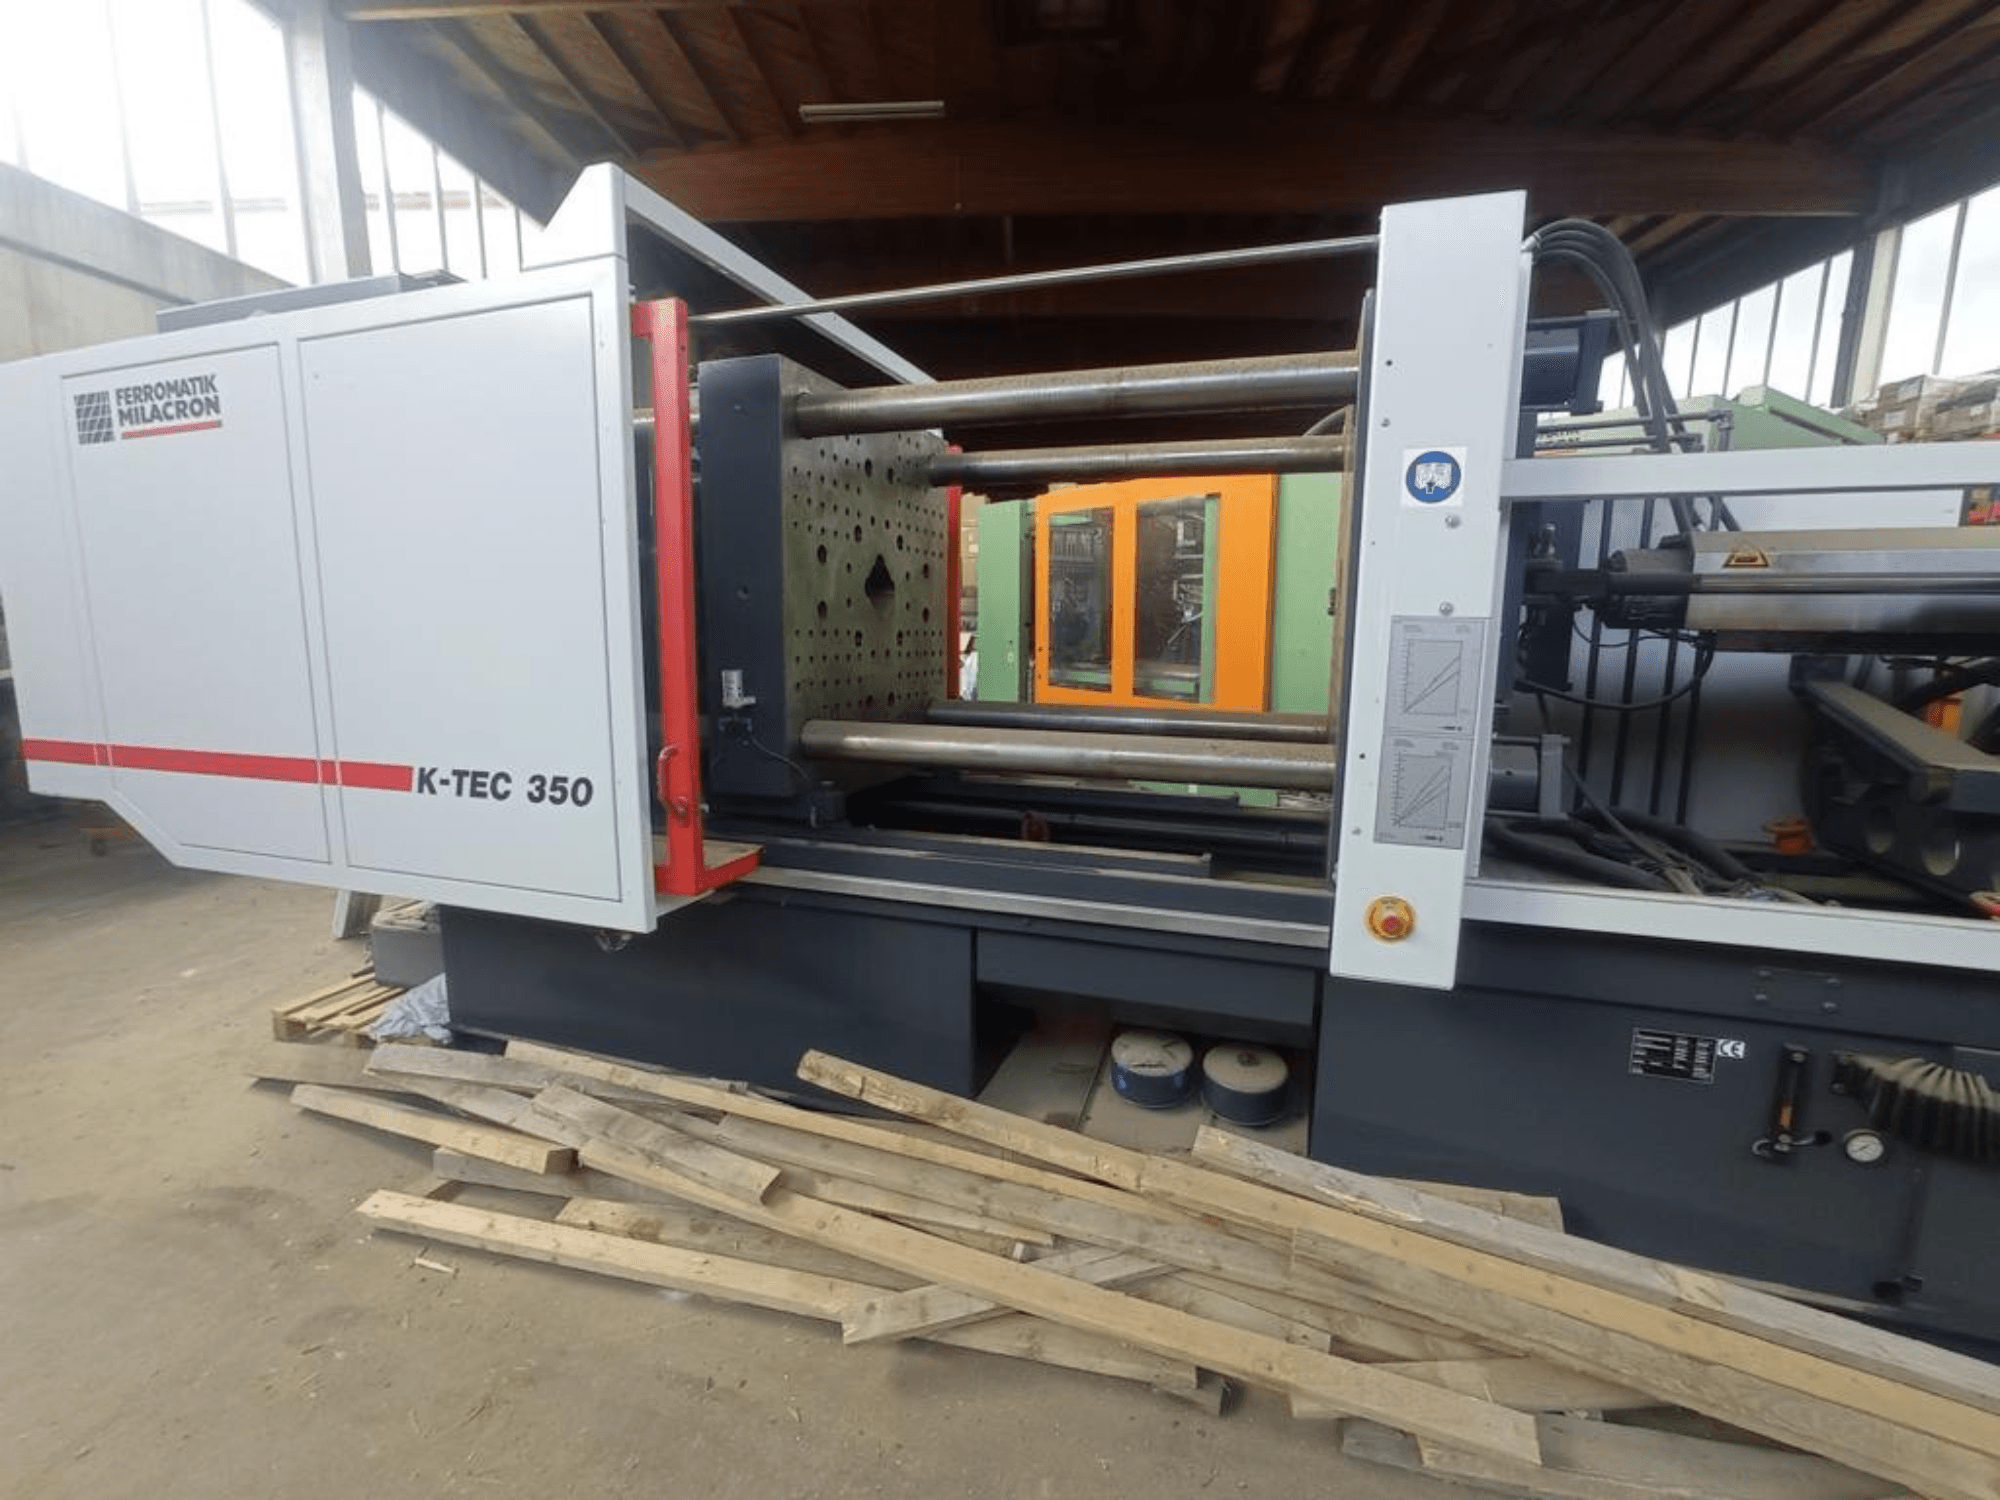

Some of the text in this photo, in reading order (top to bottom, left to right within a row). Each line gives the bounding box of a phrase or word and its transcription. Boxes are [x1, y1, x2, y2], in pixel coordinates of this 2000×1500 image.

[115, 374, 218, 406] FERROMATIK
[117, 395, 220, 426] MILACRON
[417, 767, 594, 807] K-TEC 350
[1720, 1040, 1742, 1058] CE
